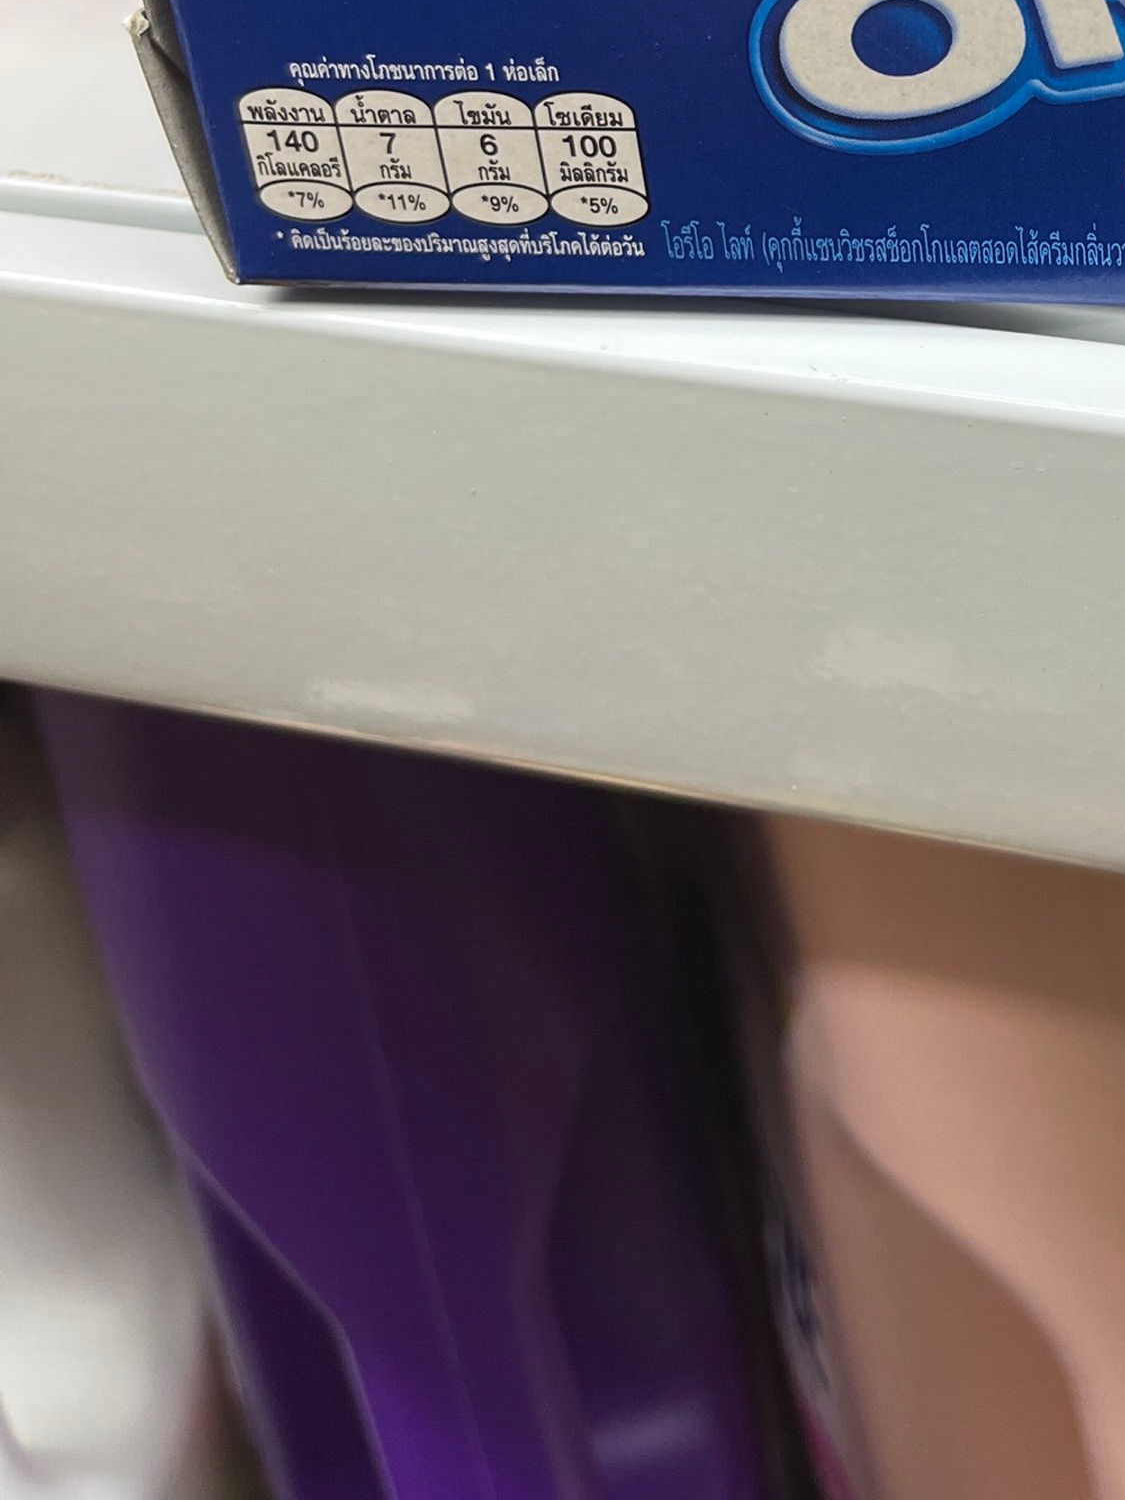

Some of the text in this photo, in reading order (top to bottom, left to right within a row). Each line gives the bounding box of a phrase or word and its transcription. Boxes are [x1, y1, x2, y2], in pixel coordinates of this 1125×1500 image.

[486, 62, 496, 80] 1
[247, 98, 326, 123] พลังงาน
[350, 95, 417, 125] น้ำตาล
[457, 99, 512, 126] ไขมัน
[544, 101, 624, 128] โซเดียม
[267, 129, 319, 154] 140
[379, 131, 397, 154] 7
[479, 133, 499, 156] 6
[562, 135, 617, 159] 100
[257, 155, 343, 179] กิโลแคลอรี
[379, 157, 412, 181] กรัม
[478, 160, 511, 182] กรัม
[559, 160, 629, 184] มิลลิกรัม
